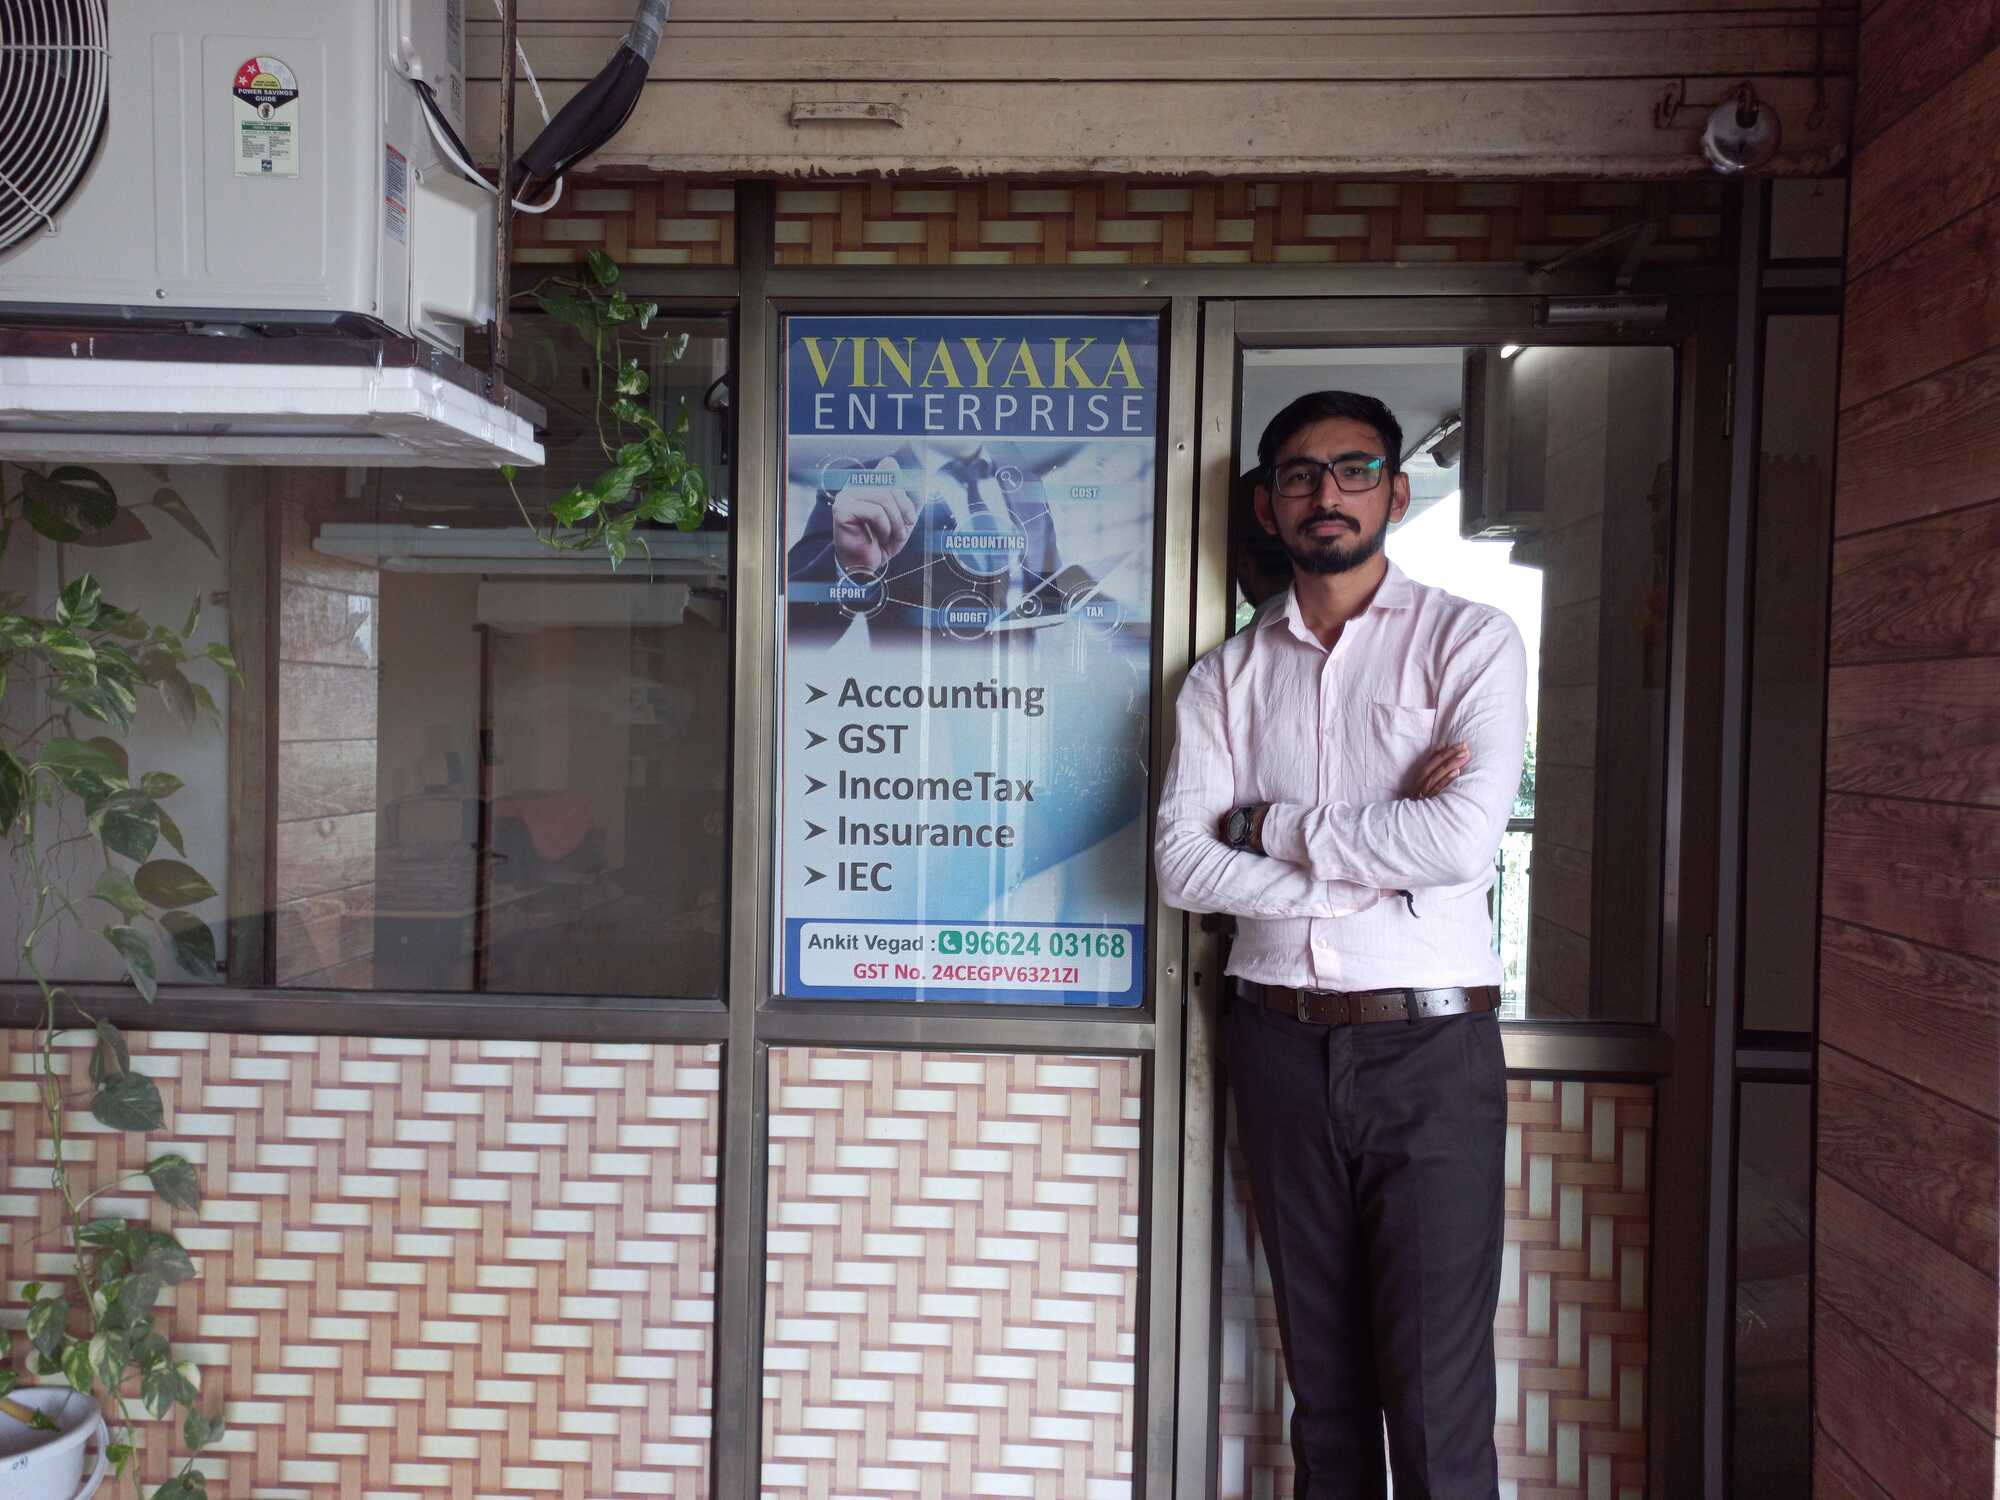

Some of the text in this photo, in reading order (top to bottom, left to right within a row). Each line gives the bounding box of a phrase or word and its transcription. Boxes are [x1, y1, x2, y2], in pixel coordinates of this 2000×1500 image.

[801, 336, 1145, 389] VINAYAKA
[814, 392, 1143, 432] ENTERPRISE
[851, 473, 895, 486] REVENUE
[1071, 486, 1098, 499] COST
[945, 535, 1025, 550] ACCOUNTING
[829, 587, 867, 600] REPORT
[949, 611, 988, 624] BUDGET
[1085, 605, 1104, 618] TAX
[837, 677, 1045, 717] Accounting
[837, 723, 909, 754] GST
[838, 769, 1036, 802] IncomeTax
[838, 815, 1016, 849] Insurance
[838, 861, 893, 892] IEC
[807, 933, 859, 951] Ankit
[864, 934, 924, 955] Vegad
[964, 930, 1041, 957] 96624
[1049, 932, 1126, 958] 03168
[853, 963, 889, 980] GST
[894, 963, 926, 980] No.
